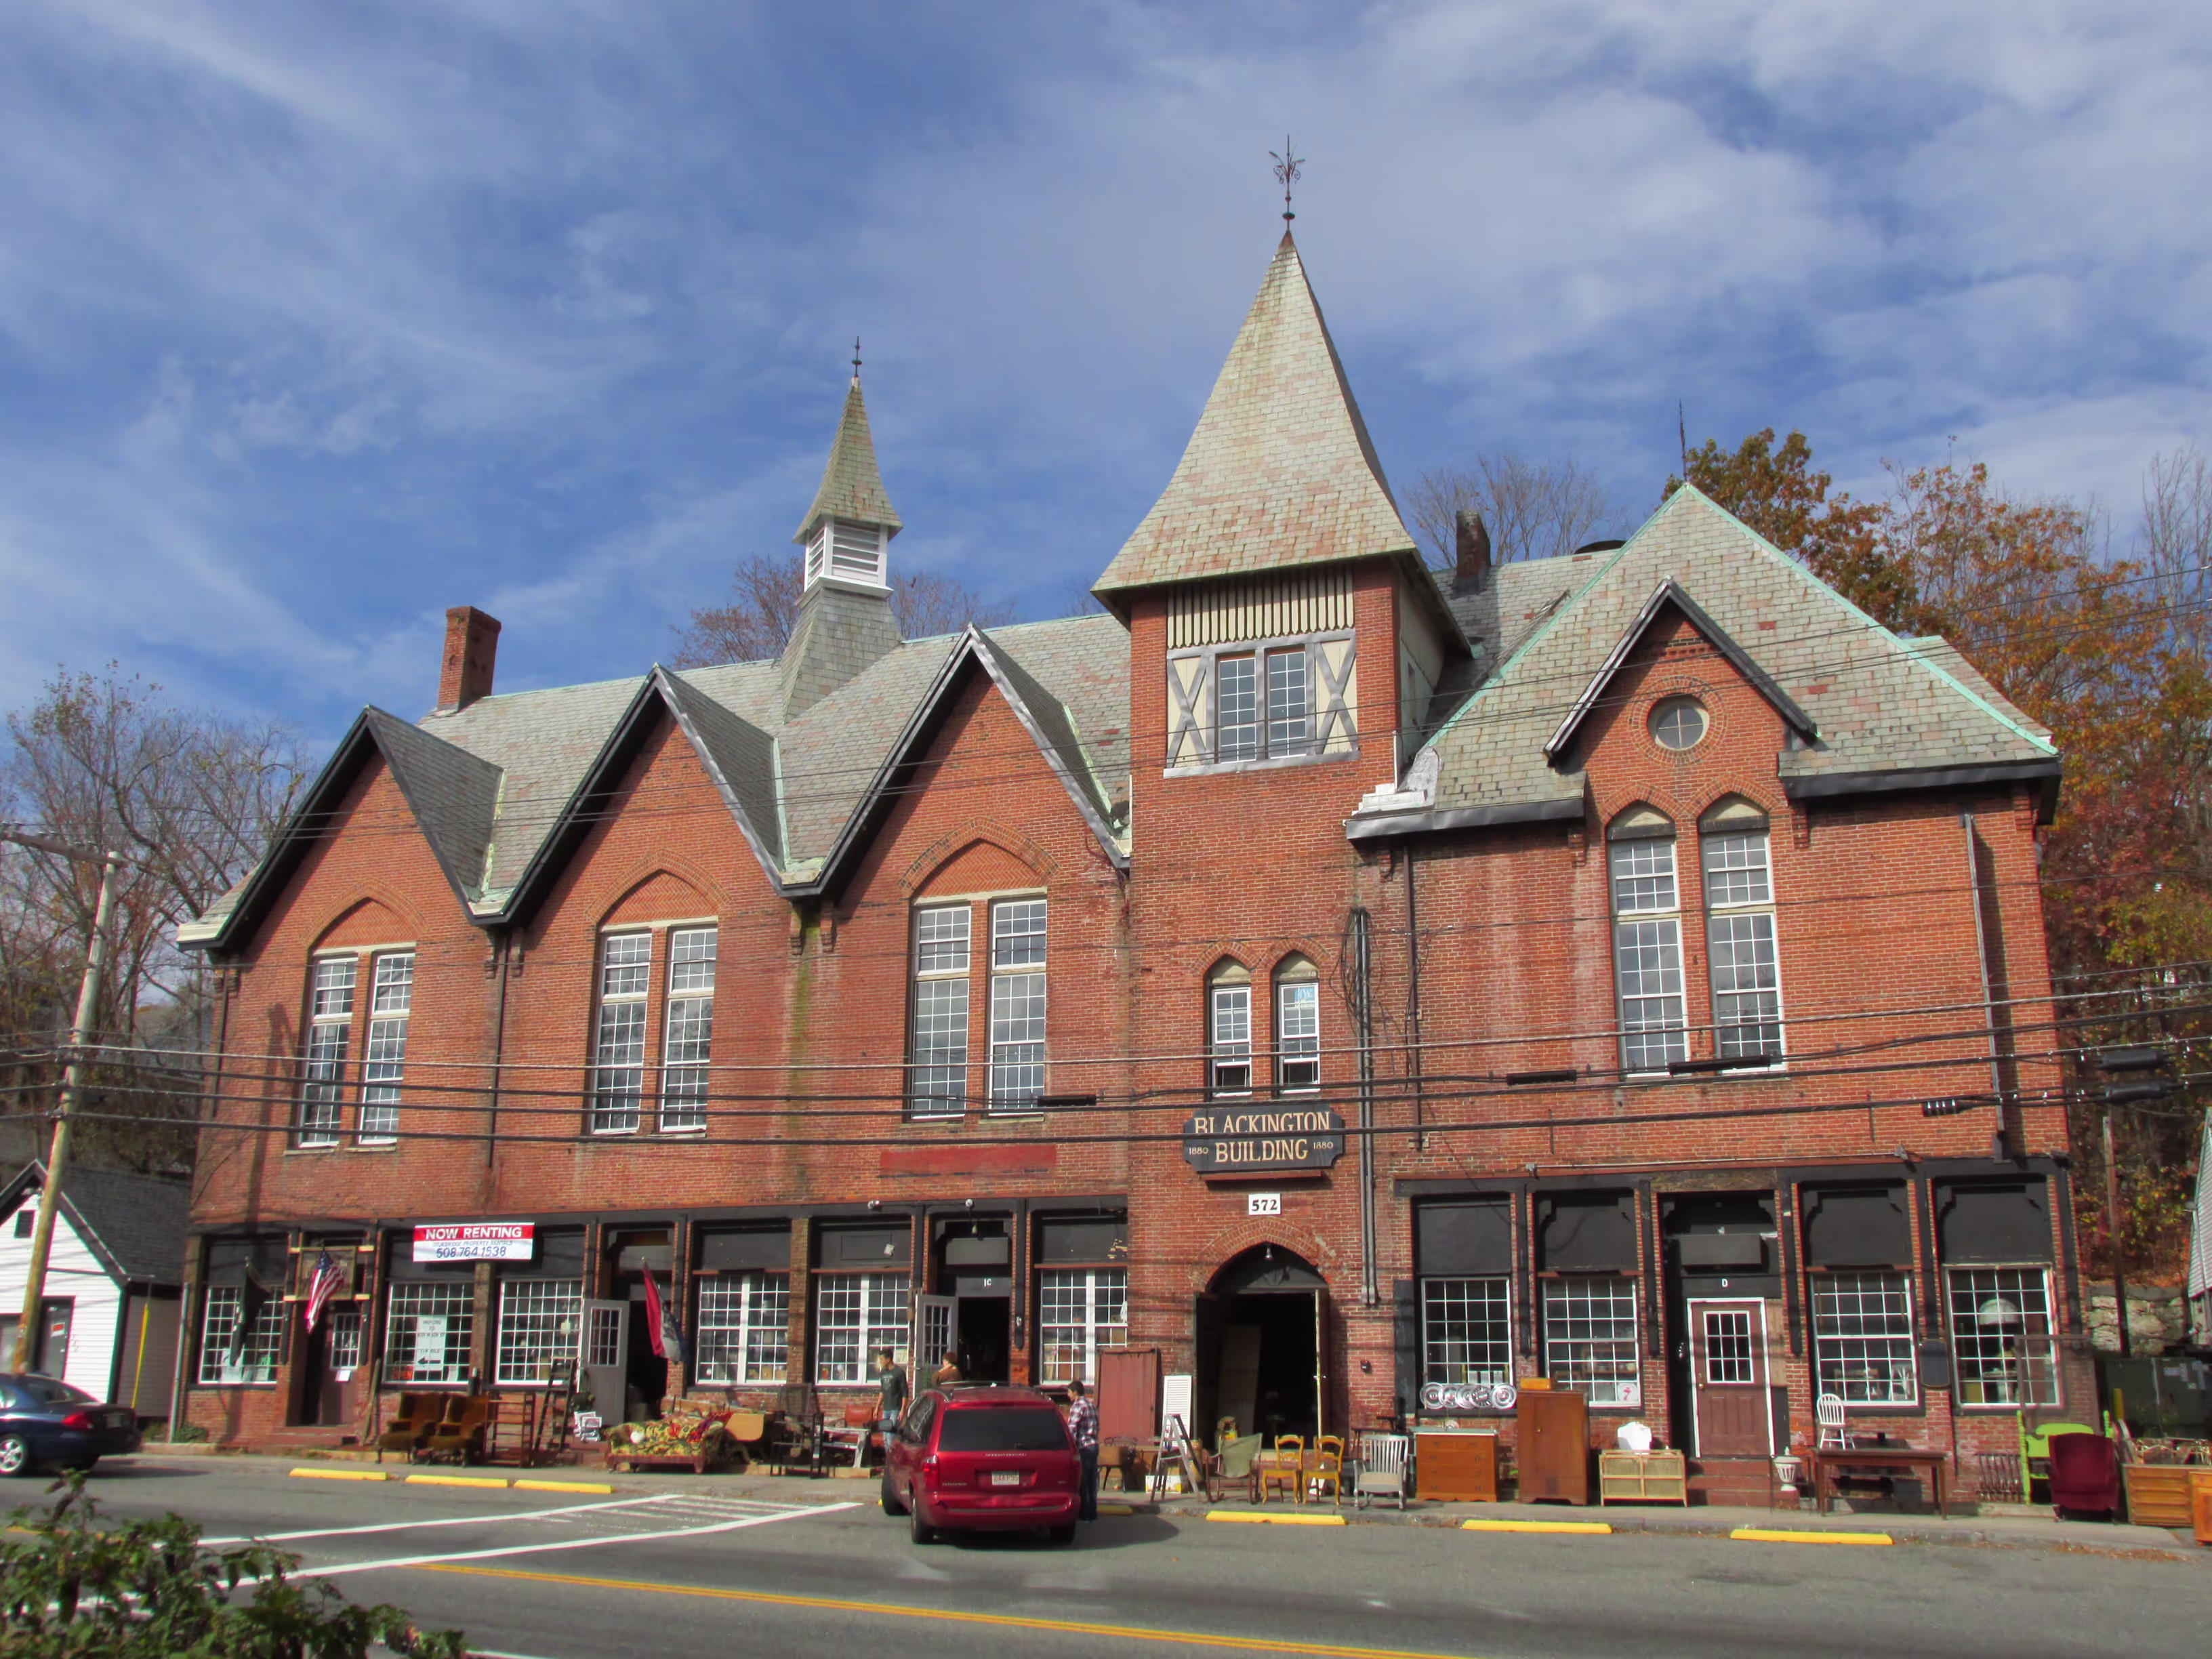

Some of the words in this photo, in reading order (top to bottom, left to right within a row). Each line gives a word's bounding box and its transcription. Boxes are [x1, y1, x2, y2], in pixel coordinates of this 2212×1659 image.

[1194, 1111, 1330, 1134] BLACKINGTON
[1214, 1139, 1308, 1163] BUILDING
[1313, 1141, 1334, 1150] 1880
[1251, 1199, 1278, 1212] 572
[426, 1229, 458, 1240] NOW
[463, 1227, 523, 1238] RENTING
[436, 1246, 507, 1258] 508.764.1538
[1721, 1278, 1728, 1288] D
